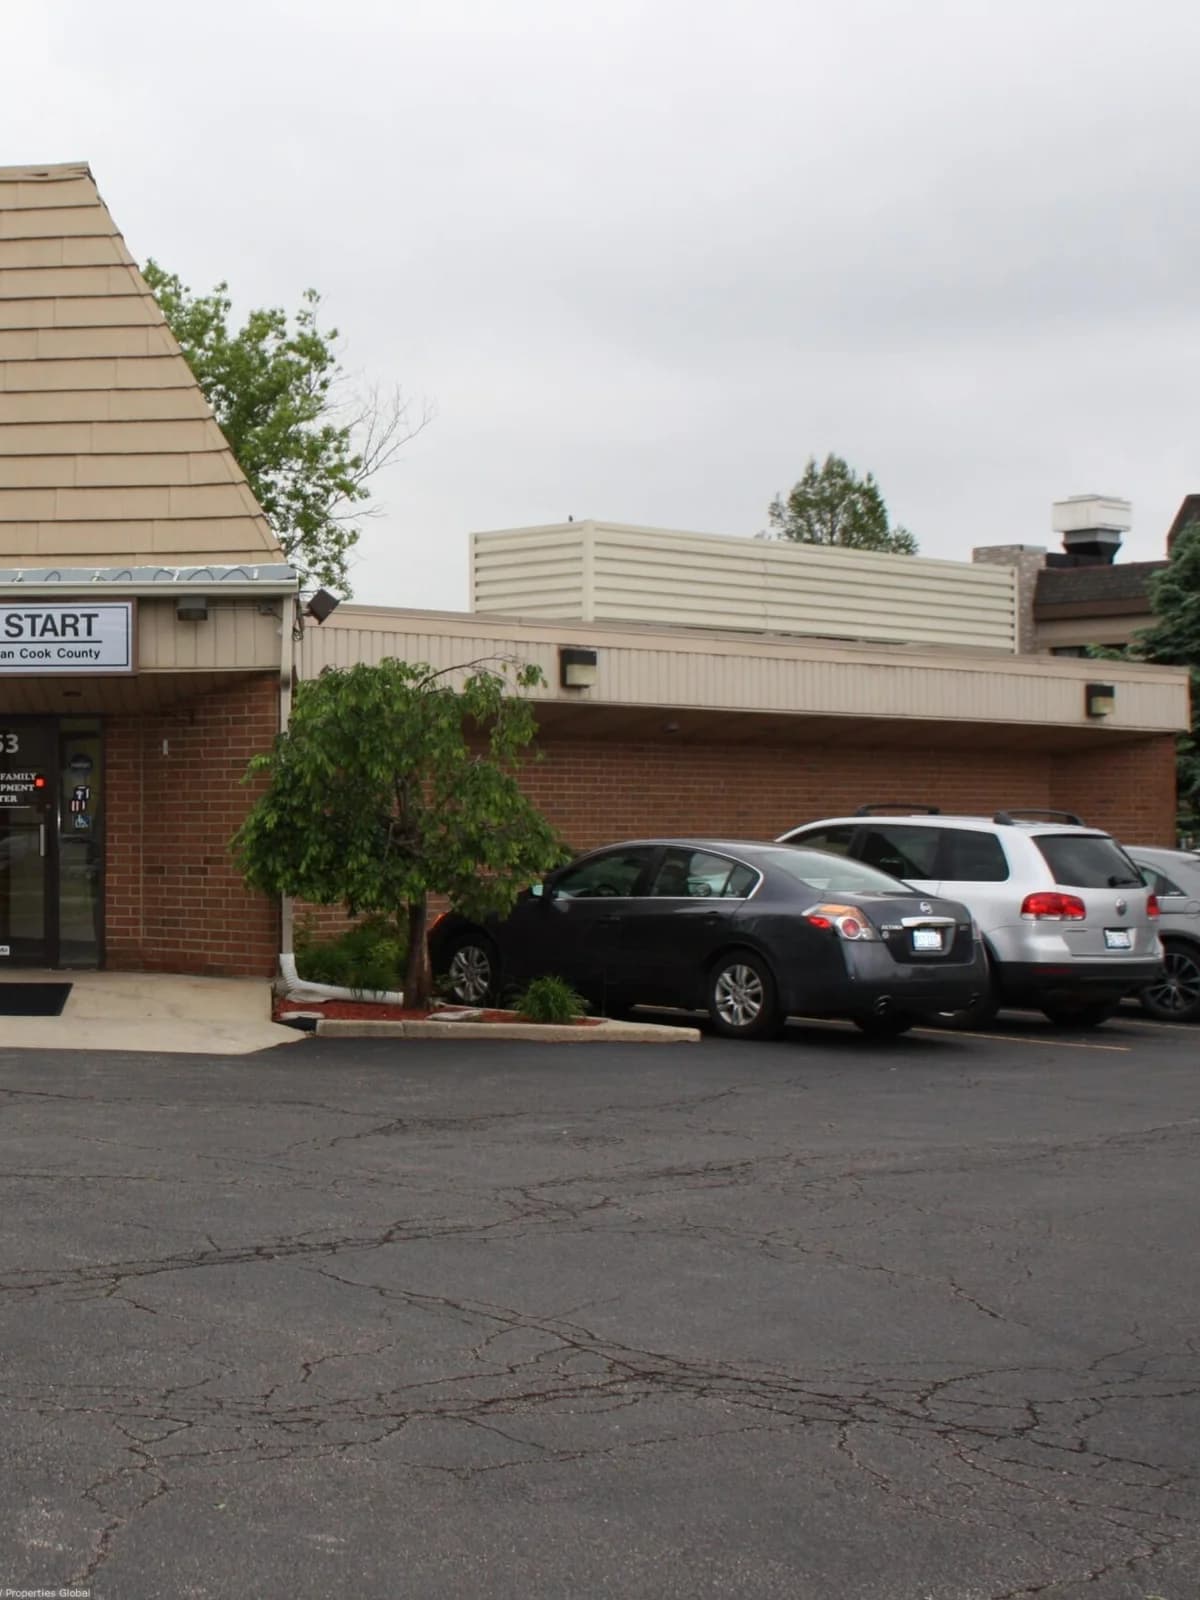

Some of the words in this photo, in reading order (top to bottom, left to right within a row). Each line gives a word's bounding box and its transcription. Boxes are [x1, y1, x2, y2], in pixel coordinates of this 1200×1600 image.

[4, 613, 99, 638] START
[19, 648, 51, 659] Cook
[57, 647, 101, 660] County
[0, 773, 37, 781] FAMILY
